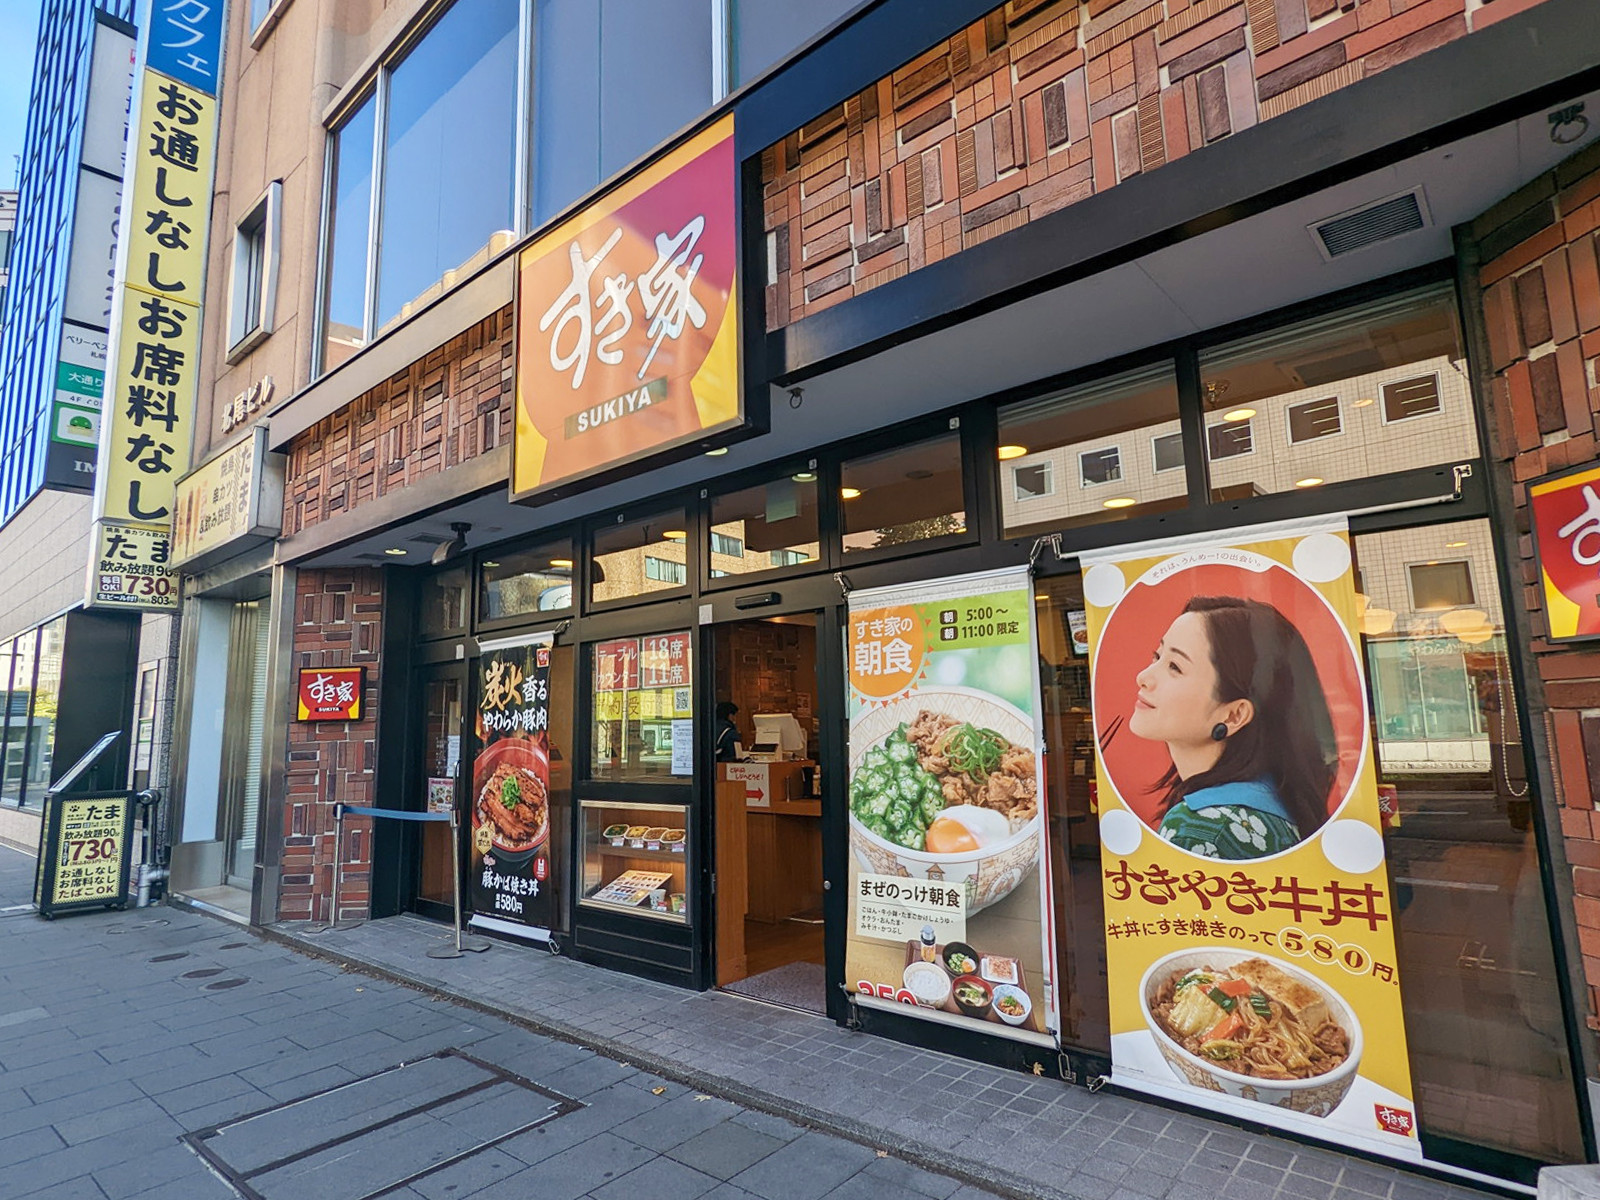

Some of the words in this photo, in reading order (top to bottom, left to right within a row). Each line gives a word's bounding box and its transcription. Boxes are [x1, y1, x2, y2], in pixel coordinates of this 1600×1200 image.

[144, 84, 204, 292] お通しなし
[539, 215, 706, 390] すき家
[126, 298, 187, 520] お席料なし
[577, 386, 652, 433] SUKIYA
[855, 616, 913, 640] すき家の
[962, 624, 994, 639] 11:00
[598, 646, 637, 661] テーブル
[854, 638, 913, 676] 朝食
[307, 673, 354, 706] すき家
[482, 706, 547, 732] やわらか豚肉
[87, 805, 121, 821] たま
[60, 866, 116, 879] お通しなし
[481, 870, 539, 897] 豚かば焼き丼
[58, 886, 114, 900] たばこOK
[860, 879, 960, 908] まぜのっけ朝食
[1104, 859, 1389, 932] すきやき牛丼
[1379, 1107, 1410, 1129] すき家
